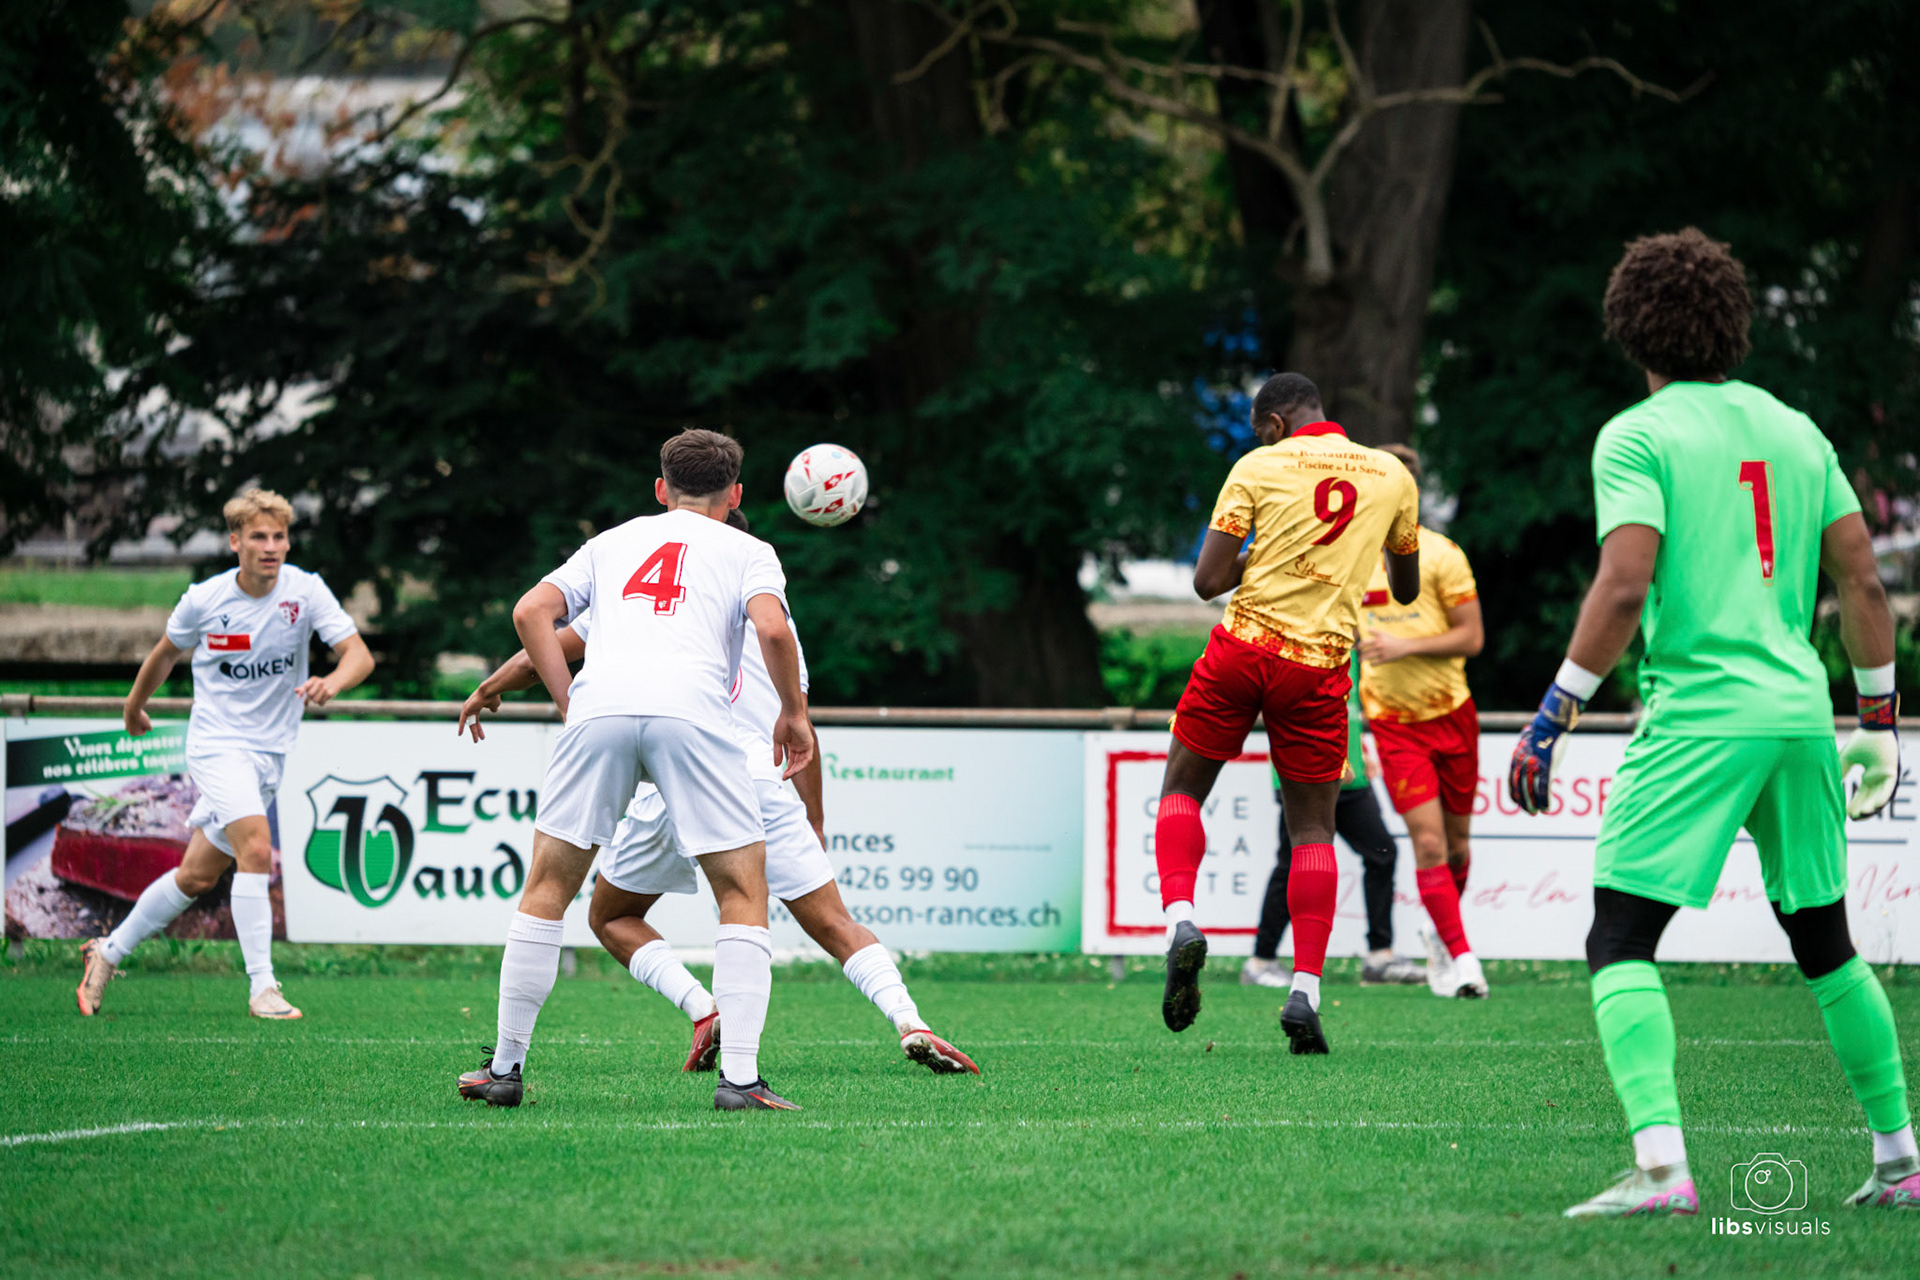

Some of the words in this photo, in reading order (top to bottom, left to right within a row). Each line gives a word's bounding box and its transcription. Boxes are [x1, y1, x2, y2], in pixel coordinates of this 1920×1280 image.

[1313, 476, 1358, 546] 9
[1739, 460, 1777, 587] 1
[622, 542, 688, 616] 4
[232, 654, 295, 680] OIKEN
[43, 763, 72, 778] nos
[822, 753, 955, 781] Restaurant
[415, 771, 538, 833] Ecu
[1143, 796, 1250, 820] CVE
[838, 865, 890, 891] 426
[900, 866, 933, 892] 99
[944, 866, 979, 892] 90
[1143, 871, 1248, 895] CTE
